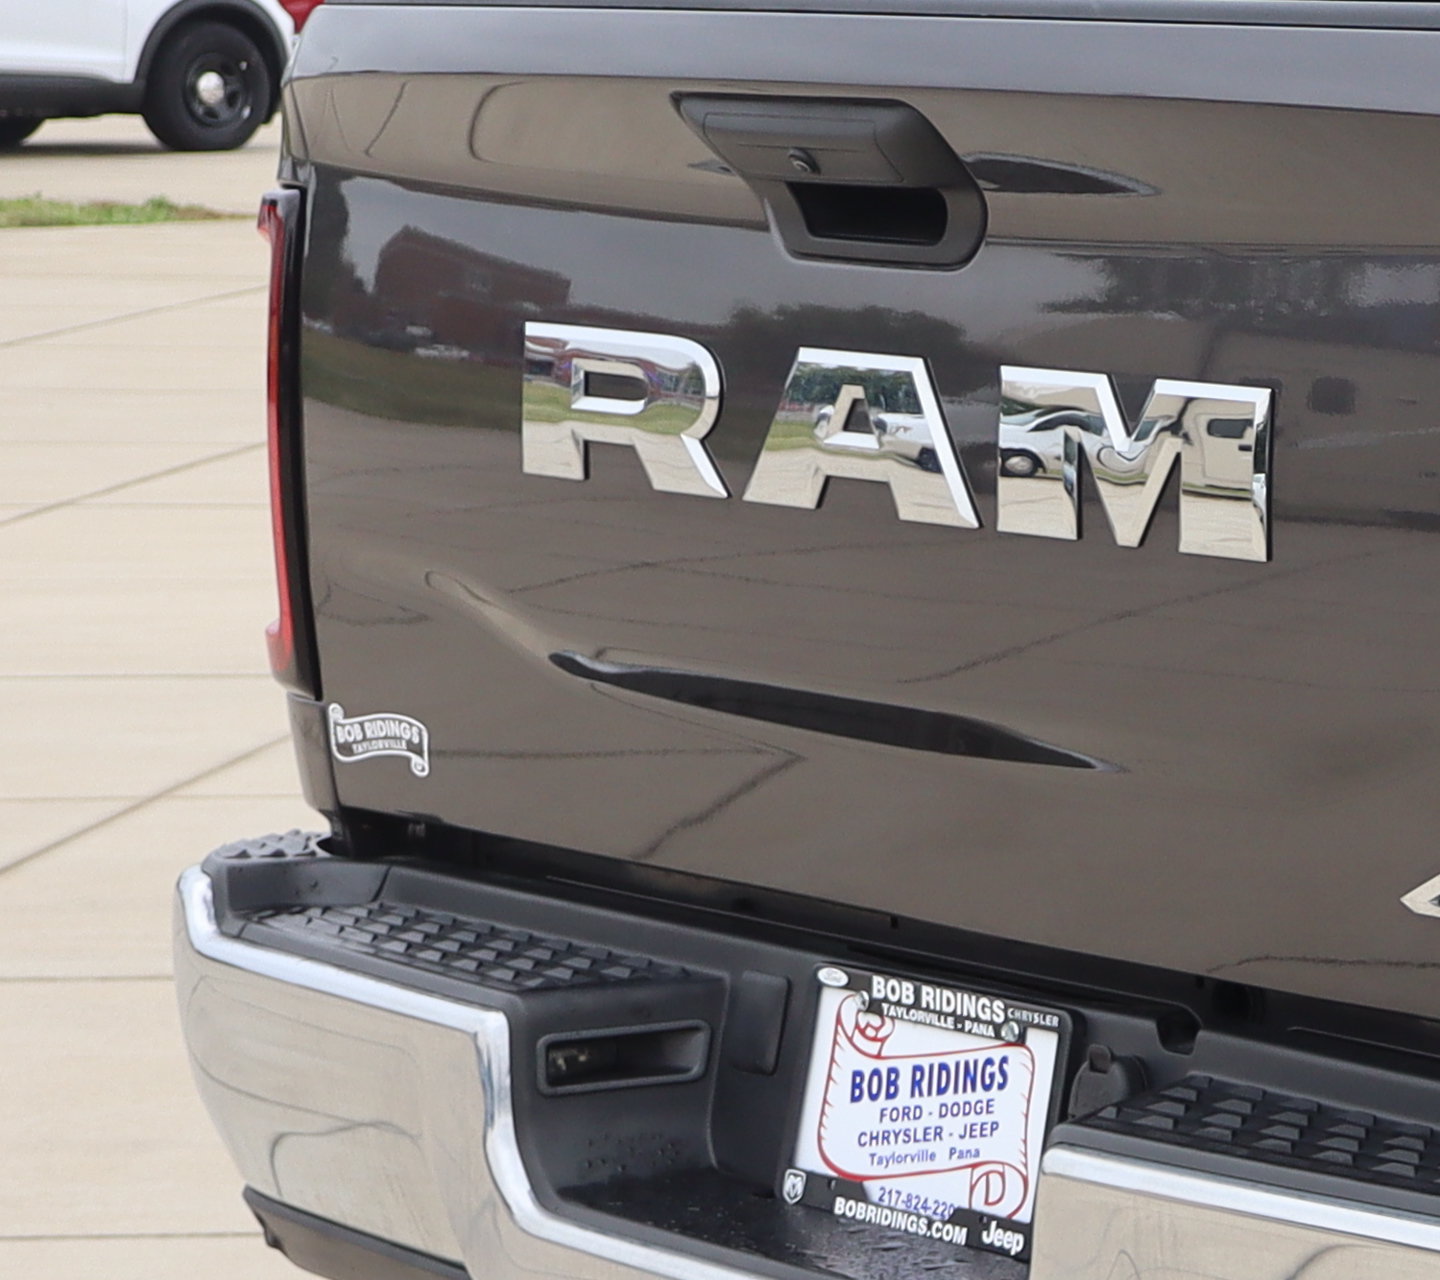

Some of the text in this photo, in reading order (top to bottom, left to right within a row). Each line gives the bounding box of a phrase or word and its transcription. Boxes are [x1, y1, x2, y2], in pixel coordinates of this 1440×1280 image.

[521, 320, 1273, 562] RAM
[336, 720, 420, 744] BOB RIDINGS
[351, 739, 408, 754] TAYLORVILLE
[872, 974, 1006, 1024] BOB RIDINGS
[881, 1002, 955, 1030] TAYLORVILLE
[964, 1019, 996, 1038] PANA
[1007, 1007, 1060, 1028] CHRYSLER
[850, 1054, 1010, 1104] BOB RIDINGS
[879, 1104, 923, 1123] FORD
[938, 1098, 996, 1119] DODGE
[857, 1125, 944, 1148] CHRYSLER
[958, 1121, 1000, 1140] JEEP
[869, 1146, 981, 1169] Taylorville Pana
[833, 1196, 968, 1246] BOBRIDINGS.COM
[981, 1220, 1025, 1256] Jeep
